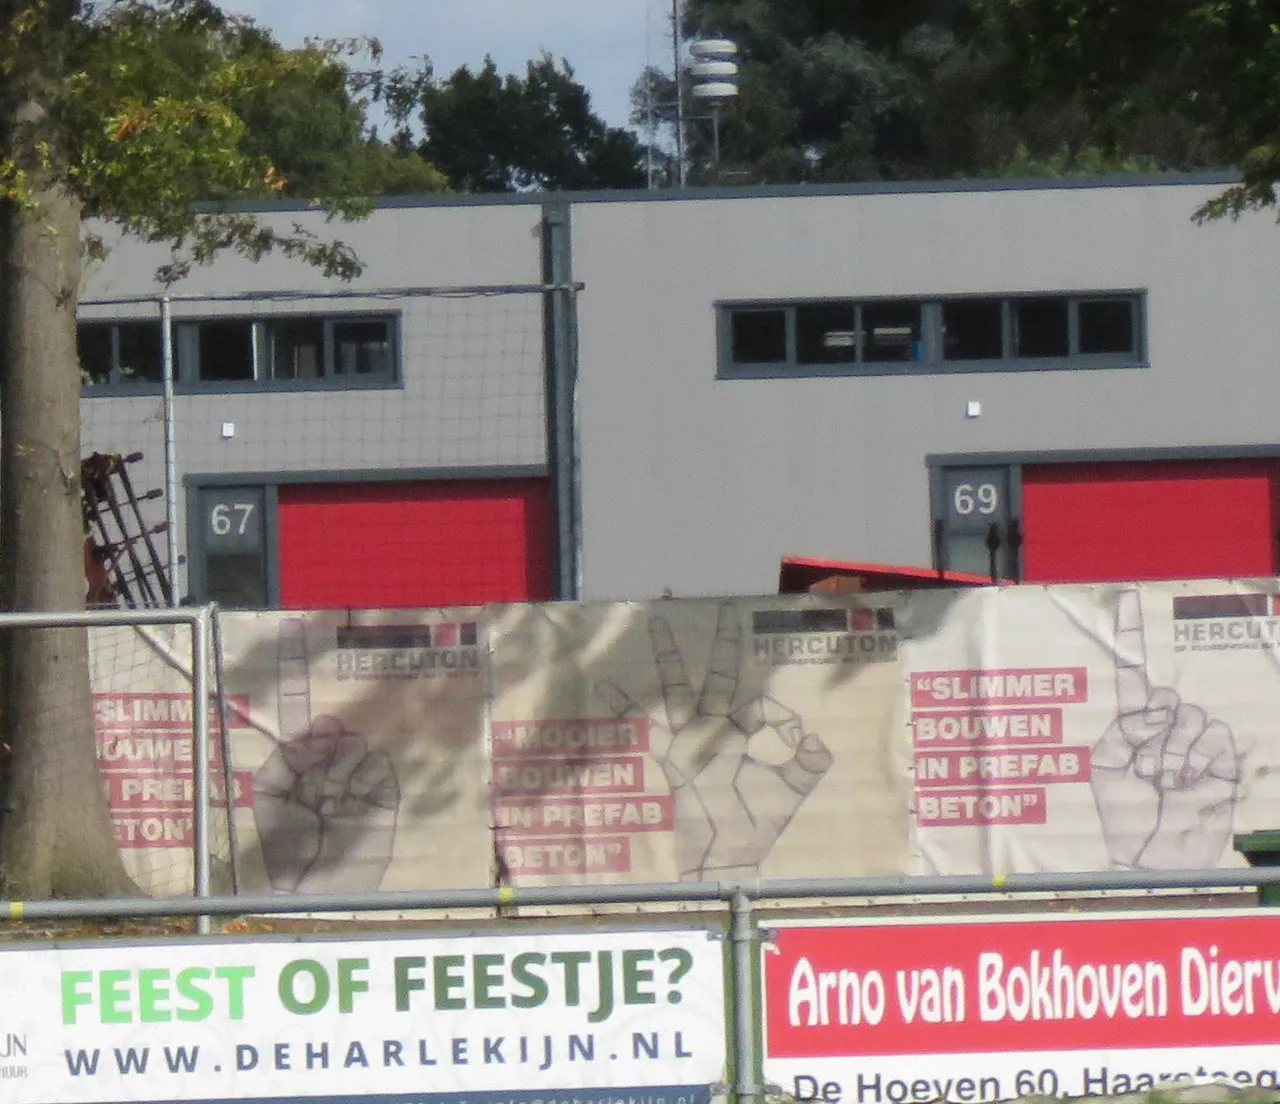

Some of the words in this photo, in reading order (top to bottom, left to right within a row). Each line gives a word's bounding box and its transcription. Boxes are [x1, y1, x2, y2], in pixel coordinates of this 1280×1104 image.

[954, 483, 998, 515] 69
[210, 503, 255, 535] 67
[916, 713, 1052, 740] BOUWEN
[498, 762, 635, 789] BOUWEN
[917, 756, 949, 780] IN
[959, 752, 1080, 779] PREFAB
[502, 805, 532, 828] IN
[543, 801, 663, 827] PREFAB
[60, 965, 256, 1026] FEEST
[277, 957, 370, 1016] OF
[393, 946, 694, 1024] FEESTJE?
[788, 956, 886, 1027] Arno
[896, 966, 966, 1024] van
[978, 947, 1169, 1023] Bokhoven
[64, 1030, 693, 1077] WWW.DEHARLEKIJN.NL
[793, 1074, 842, 1100] De
[856, 1073, 1001, 1103] Hoeven
